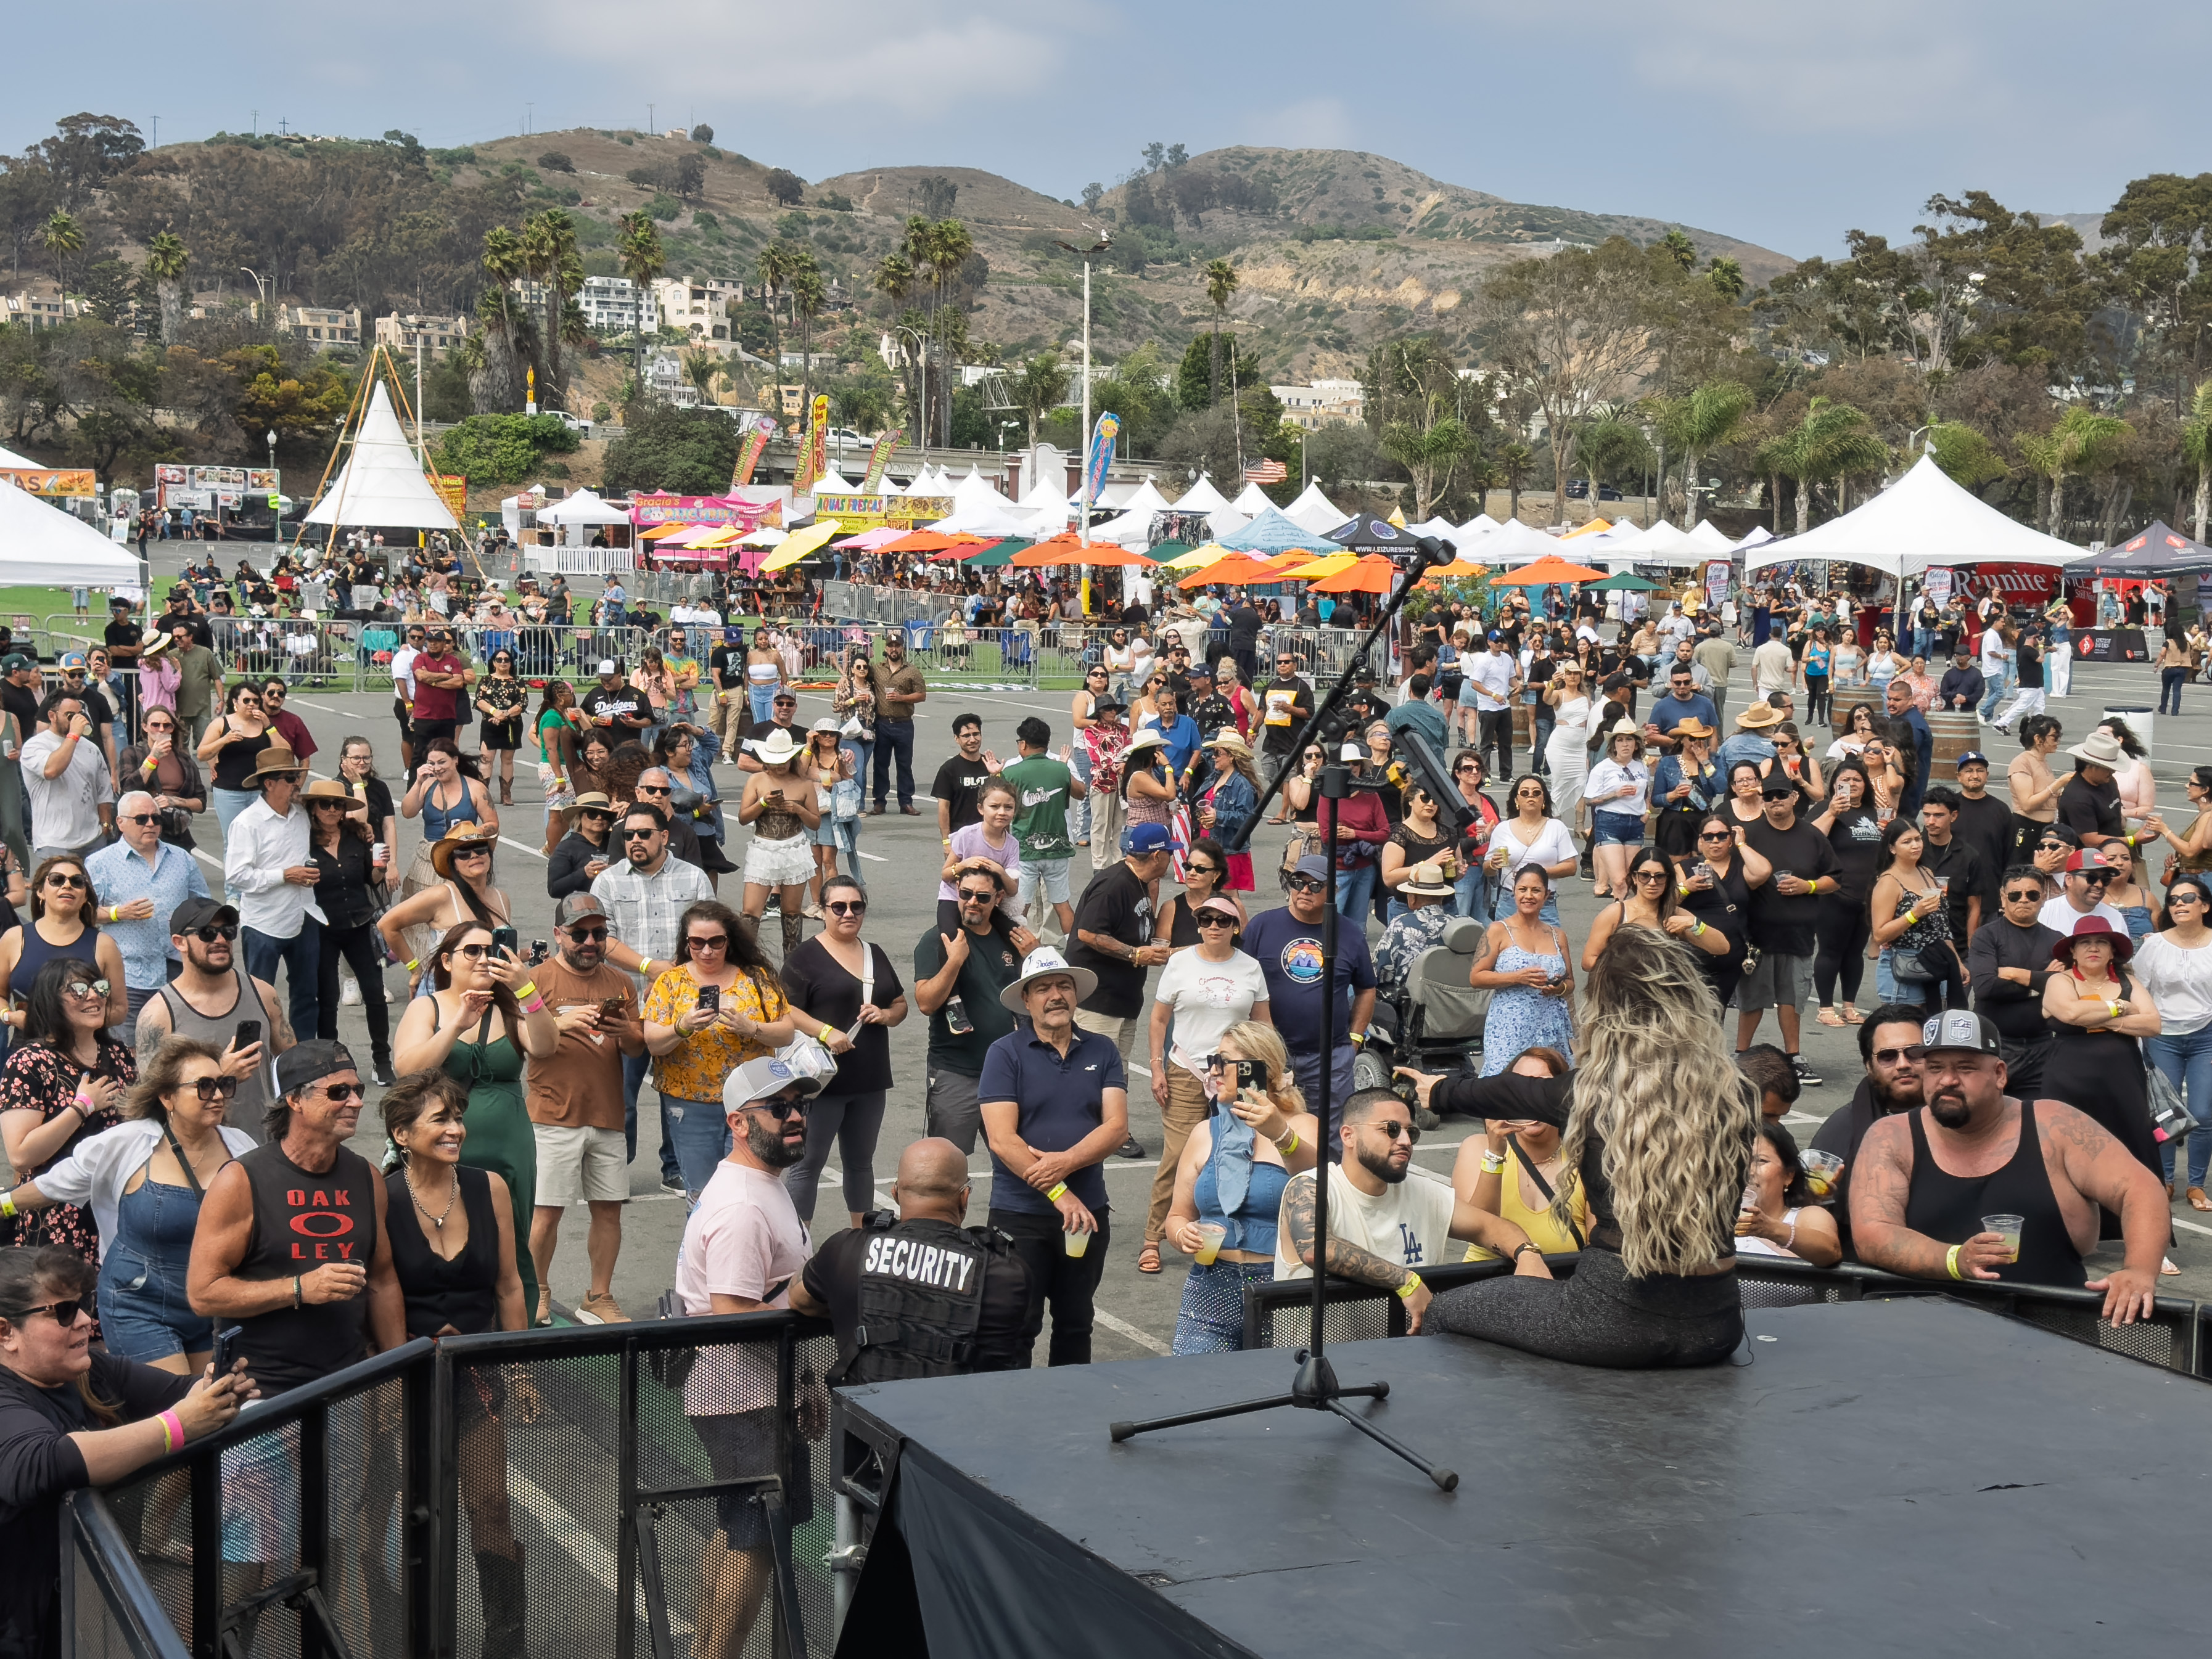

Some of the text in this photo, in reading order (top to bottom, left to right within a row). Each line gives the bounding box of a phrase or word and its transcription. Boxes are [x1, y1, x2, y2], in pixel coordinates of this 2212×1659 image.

[1101, 424, 1117, 433] SUN
[734, 428, 759, 480] FUNNEL CAKE
[794, 429, 813, 481] PUPUSAS
[874, 440, 892, 464] FRIES
[636, 497, 680, 507] Gracie's
[847, 497, 883, 513] FRESCAS
[1953, 568, 2049, 600] Riunite
[594, 699, 638, 714] Dodgers
[287, 1189, 352, 1206] OAK
[290, 1241, 355, 1260] LEY
[865, 1236, 975, 1292] SECURITY
